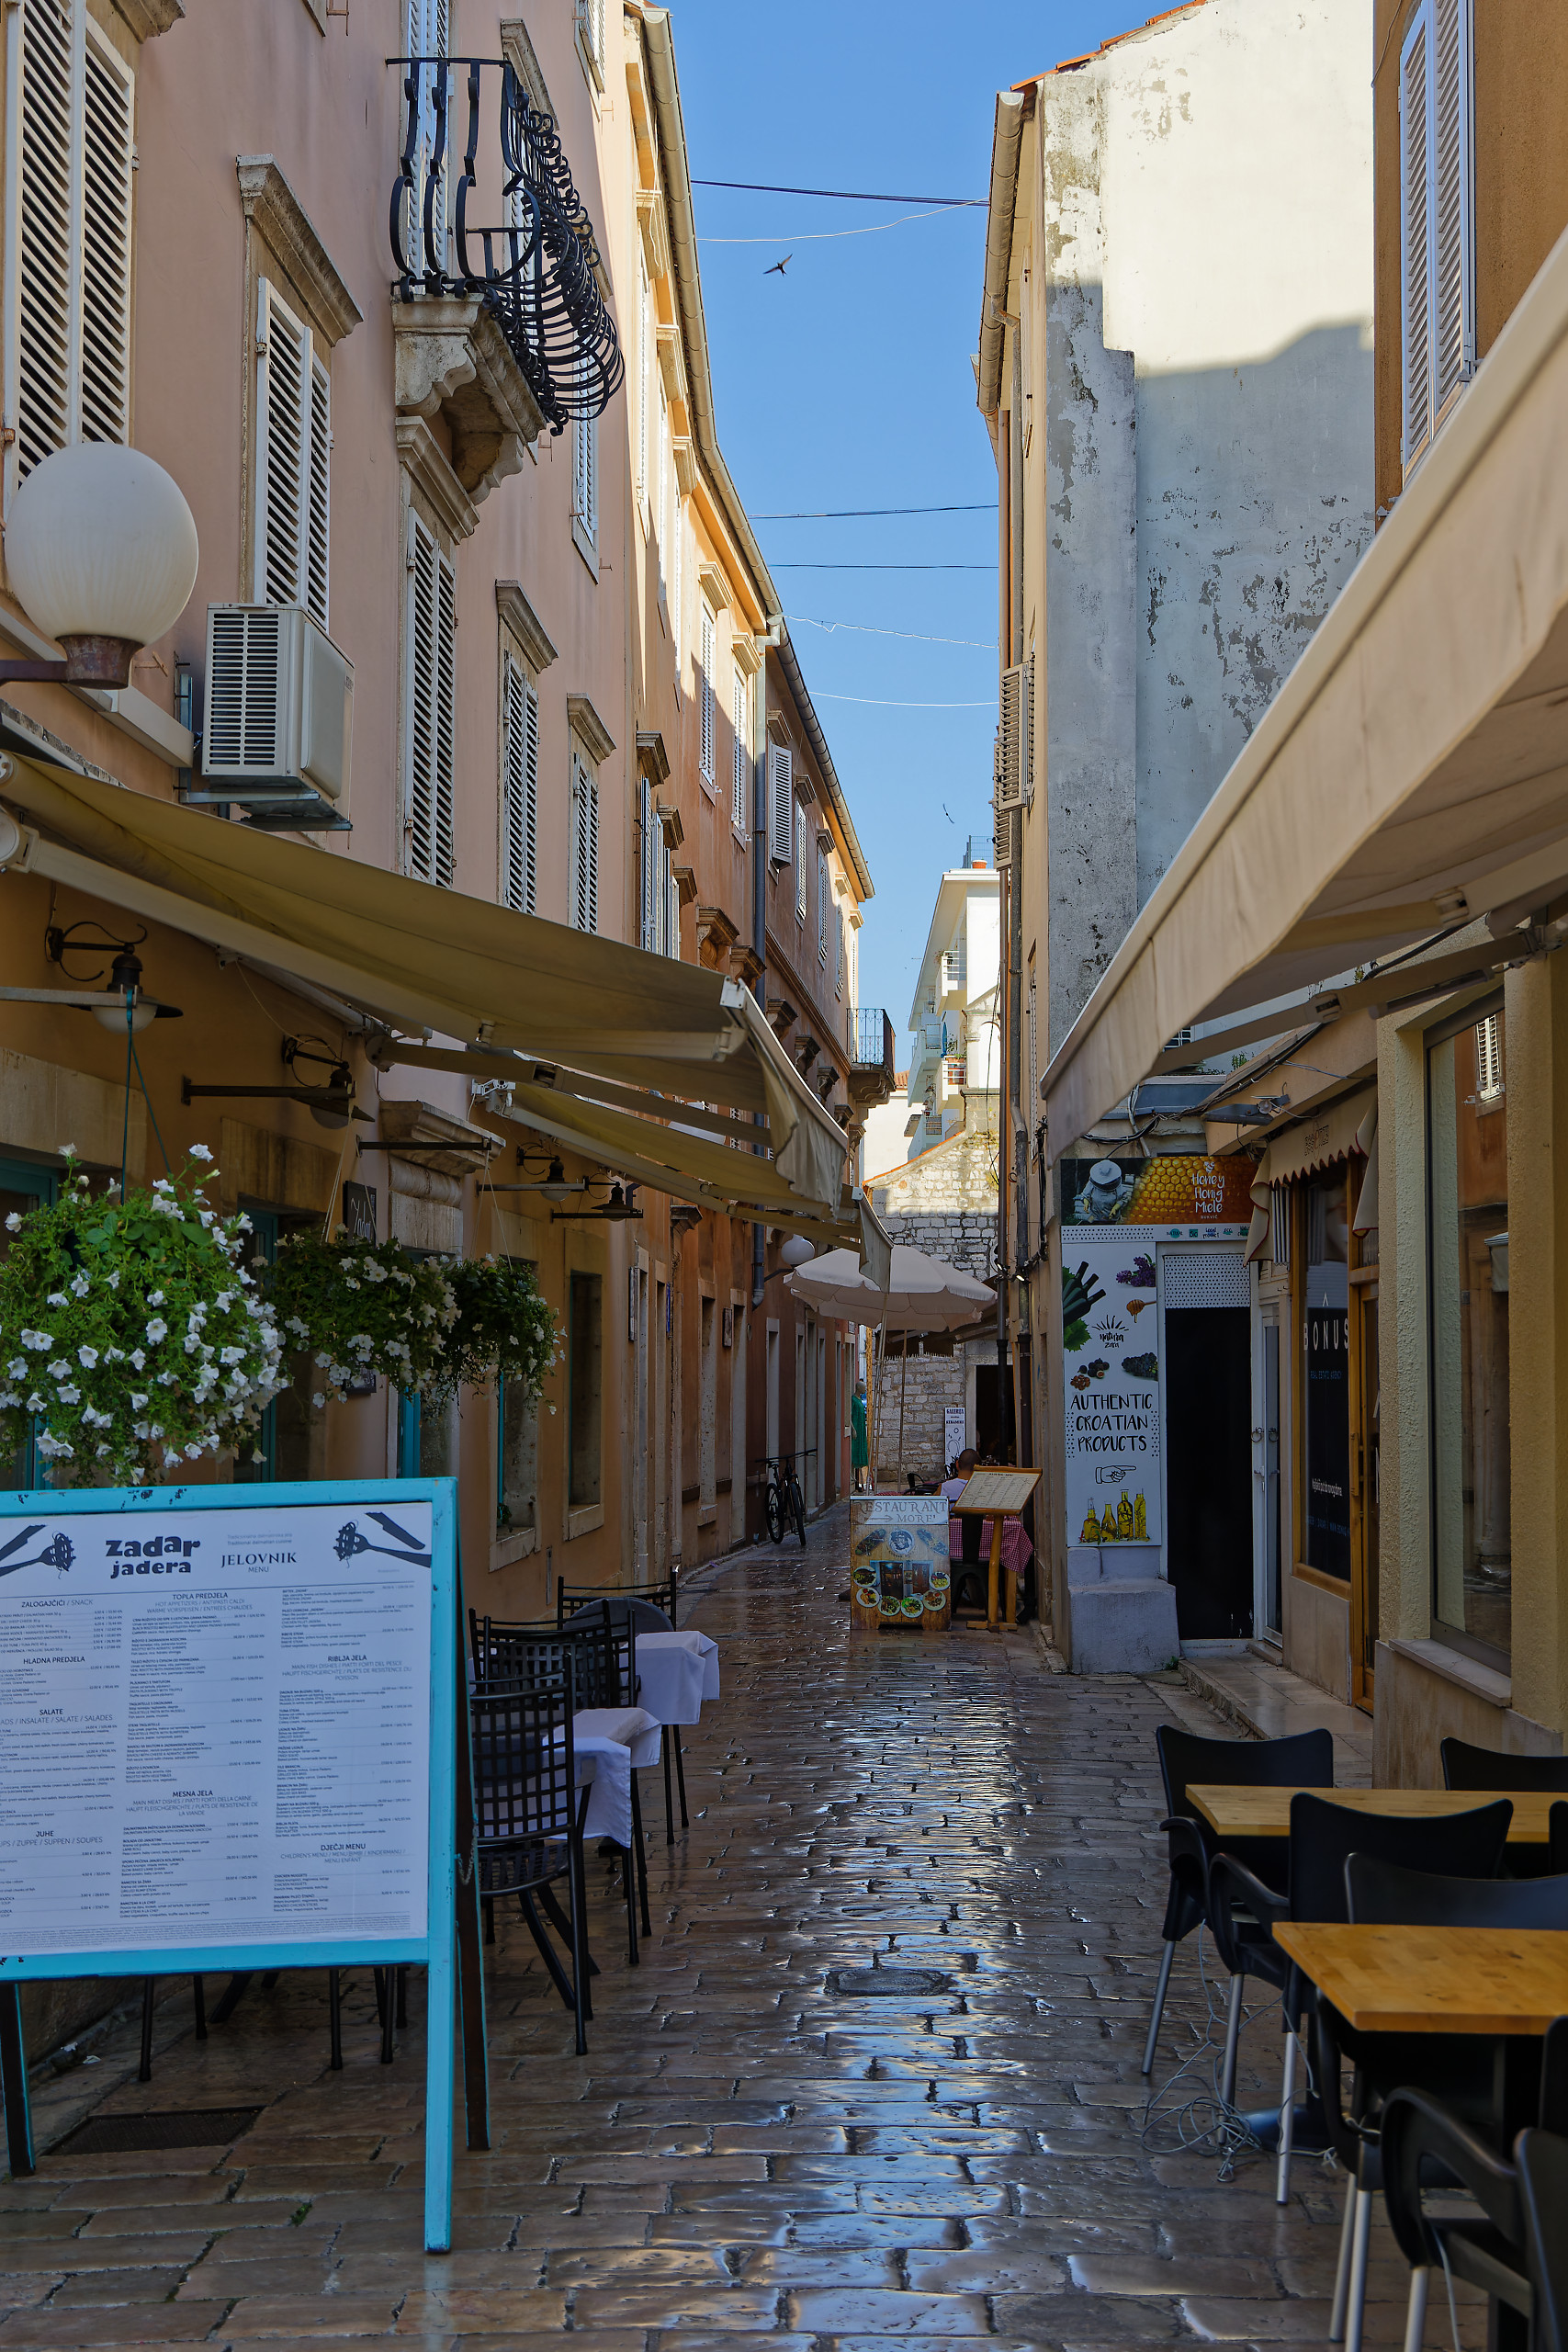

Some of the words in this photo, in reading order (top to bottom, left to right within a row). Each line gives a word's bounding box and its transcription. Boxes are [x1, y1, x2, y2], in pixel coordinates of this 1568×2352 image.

[1191, 1173, 1225, 1188] Honey
[1195, 1187, 1222, 1203] Honig
[1195, 1199, 1223, 1213] Miele
[1100, 1332, 1124, 1342] natura
[1303, 1317, 1349, 1351] BONUS
[1071, 1394, 1152, 1410] AUTHENTIC
[1077, 1415, 1147, 1431] CROATIAN
[1077, 1435, 1147, 1452] PRODUCTS
[853, 1500, 947, 1514] RESTAURANT
[106, 1536, 201, 1557] zadar
[221, 1552, 298, 1568] JELOVNIK
[110, 1560, 191, 1579] jadera
[321, 1843, 344, 1851] DJEČJI
